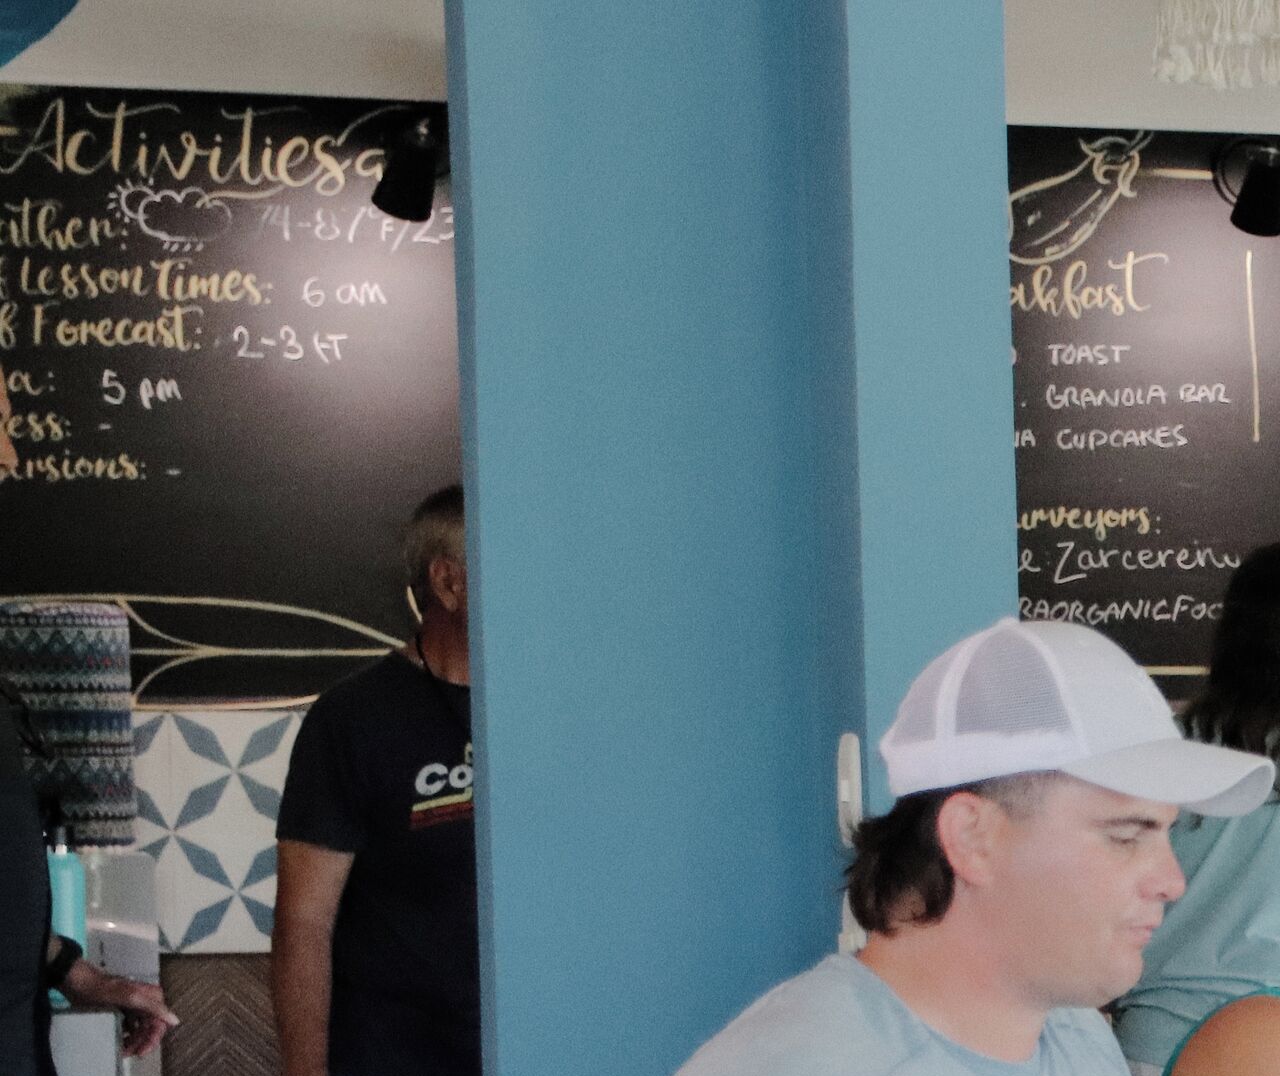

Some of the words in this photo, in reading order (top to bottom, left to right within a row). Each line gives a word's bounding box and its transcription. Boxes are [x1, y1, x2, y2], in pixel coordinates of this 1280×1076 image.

[0, 98, 352, 204] Activities
[21, 257, 149, 299] Lesson
[150, 257, 274, 306] Times:
[302, 276, 325, 307] 6
[335, 280, 388, 306] am
[33, 300, 204, 351] Forecast:
[233, 324, 304, 361] 2-3
[1048, 344, 1131, 366] TOAST
[102, 368, 126, 405] 5
[139, 377, 182, 410] pm
[1046, 384, 1166, 409] GRANOLA
[1179, 382, 1231, 404] BAR
[1056, 424, 1188, 450] CUPCAKES
